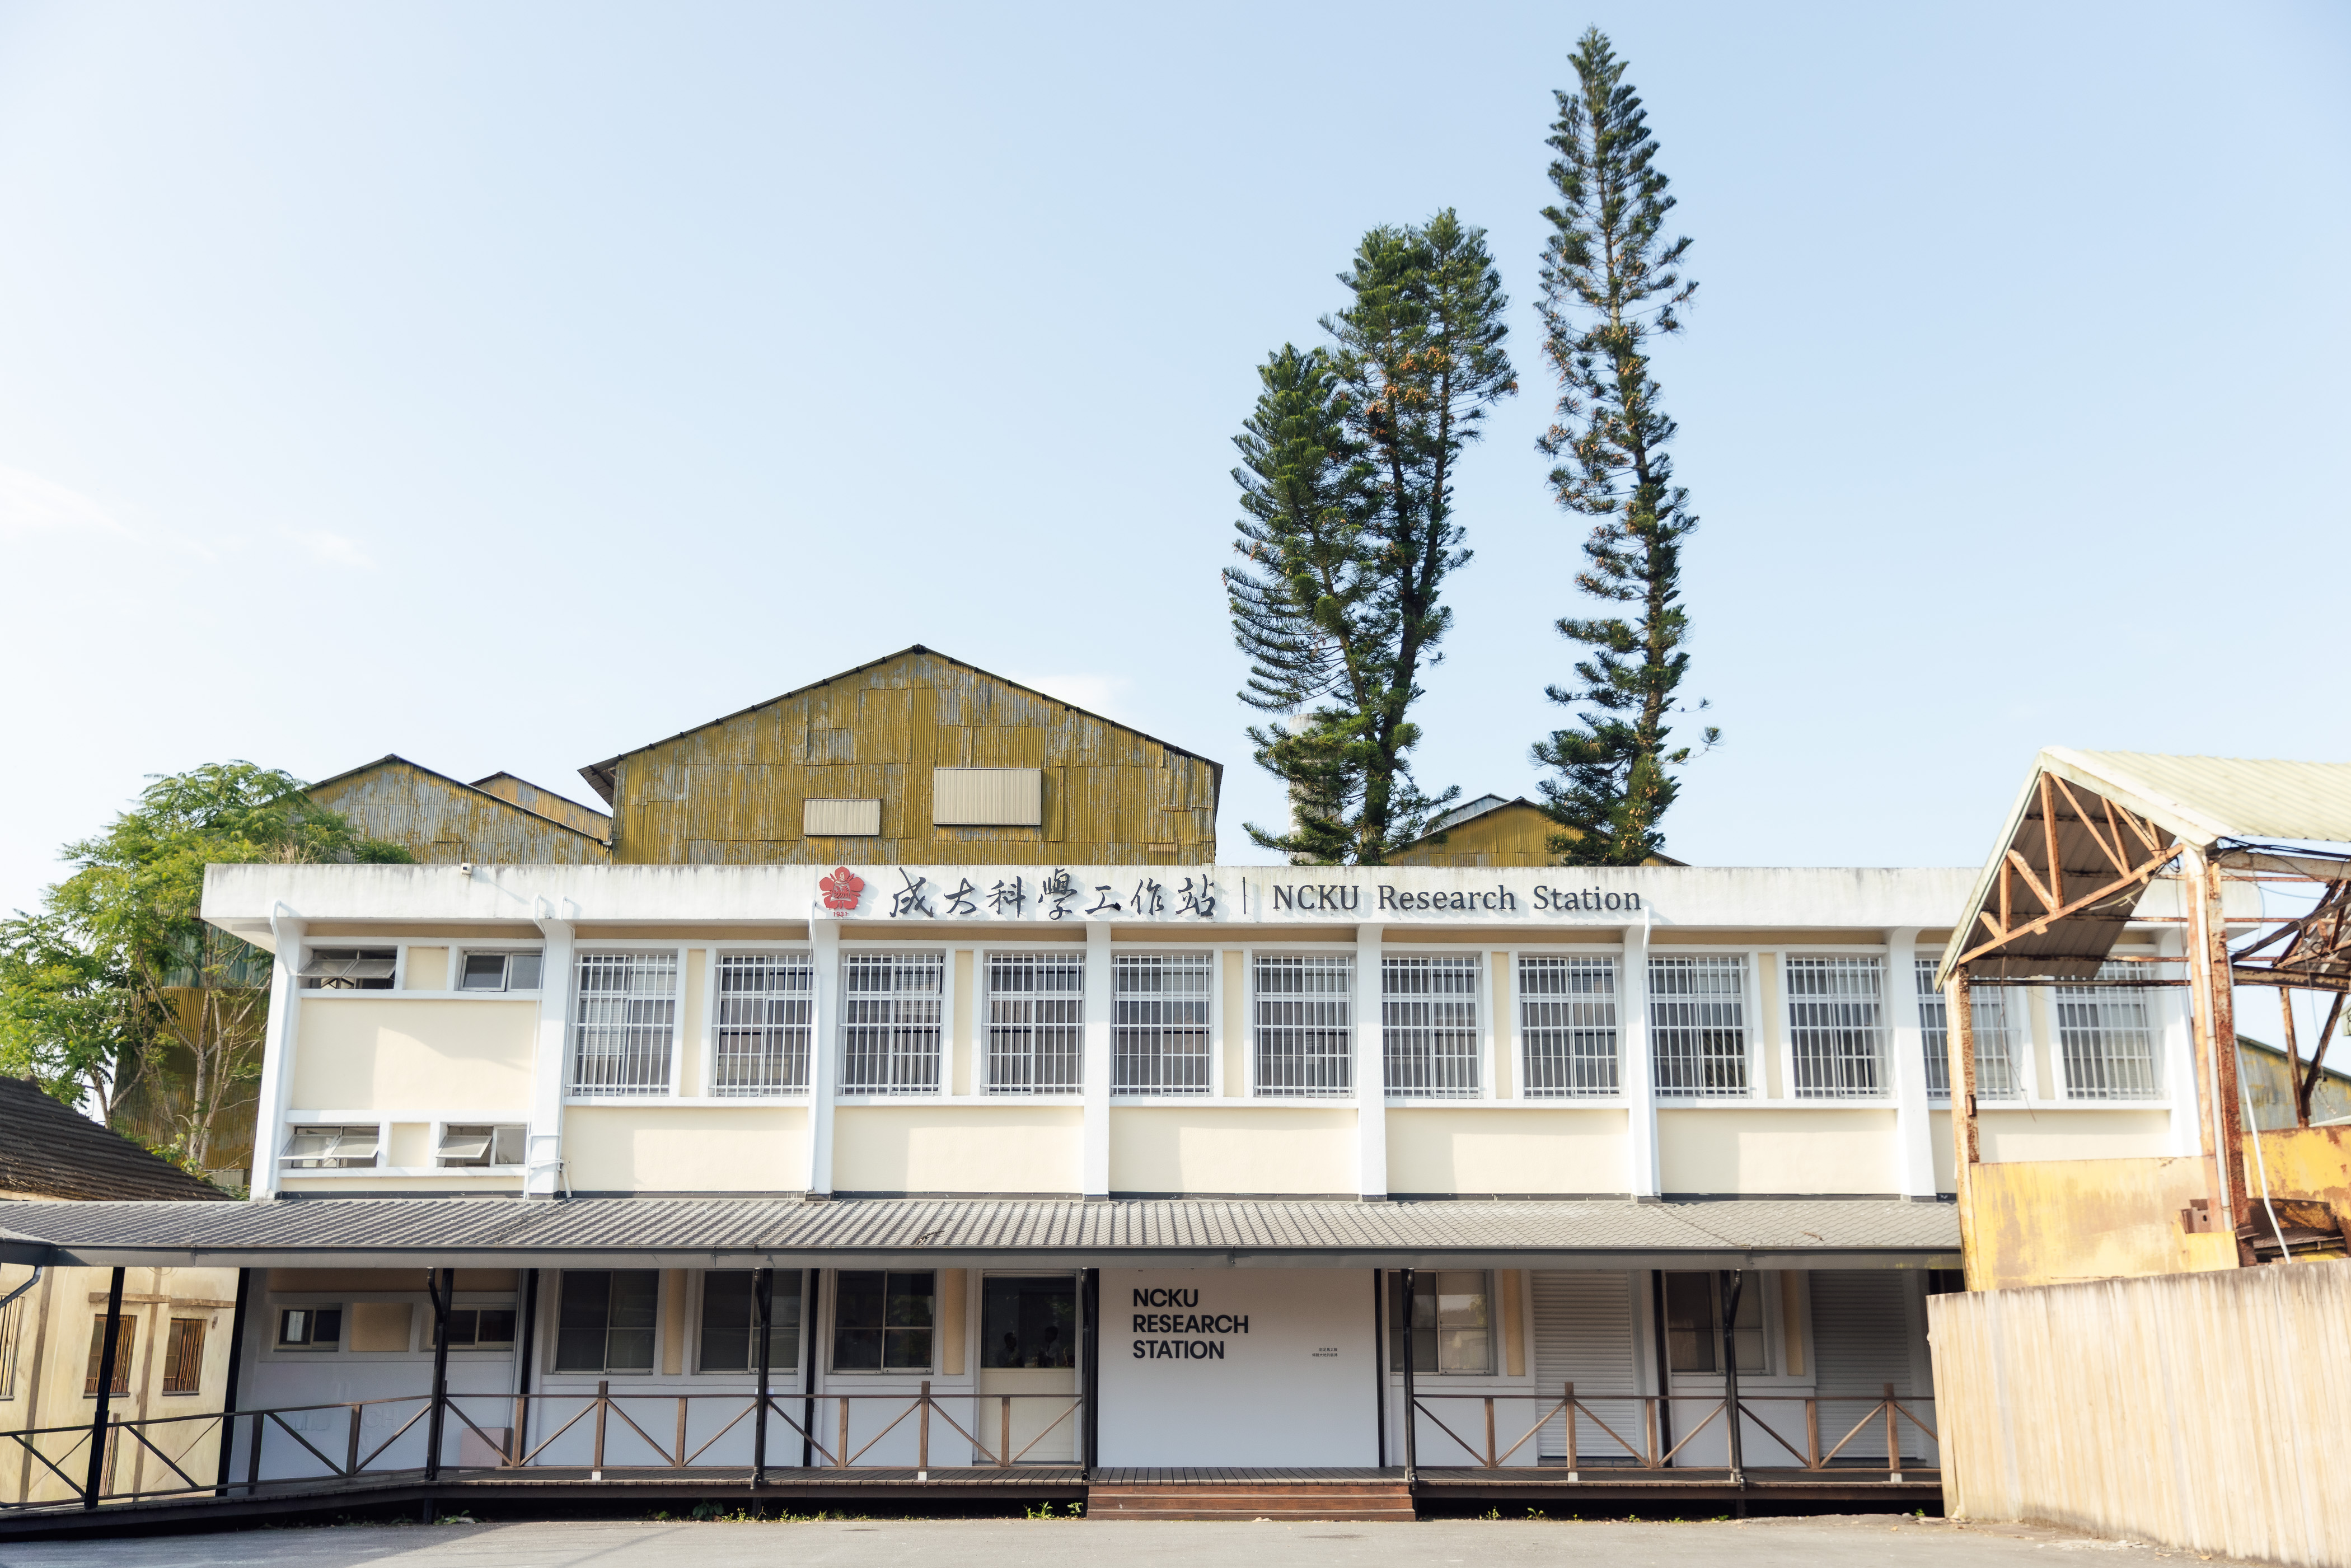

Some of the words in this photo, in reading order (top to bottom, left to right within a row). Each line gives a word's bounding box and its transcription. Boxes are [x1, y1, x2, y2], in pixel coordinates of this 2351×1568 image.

[890, 867, 1216, 920] 成大科學工作站
[1273, 884, 1359, 910] NCKU
[1378, 884, 1516, 910] Research
[1534, 885, 1641, 911] Station
[1133, 1288, 1198, 1308] NCKU
[1133, 1314, 1249, 1333] RESEARCH
[1133, 1340, 1224, 1359] STATION
